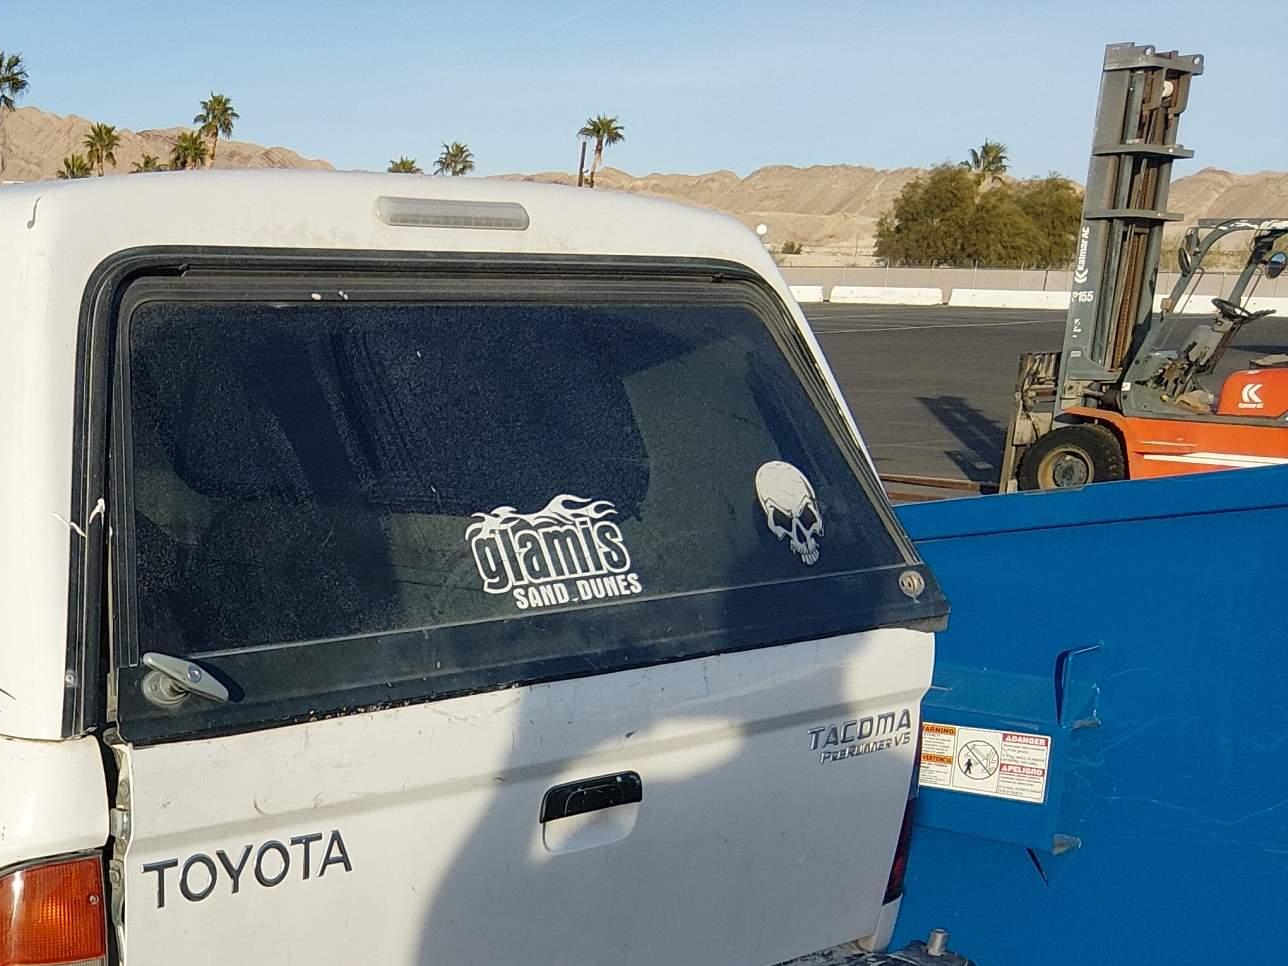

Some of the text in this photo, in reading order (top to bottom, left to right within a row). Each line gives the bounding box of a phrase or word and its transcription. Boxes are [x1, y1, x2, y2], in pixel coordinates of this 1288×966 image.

[472, 516, 631, 594] glamis
[513, 573, 643, 610] SAND DUNES
[807, 707, 912, 751] TACOMA
[1011, 736, 1047, 746] DANGER
[1007, 765, 1043, 776] PELIGRO
[140, 829, 353, 909] TOYOTA
